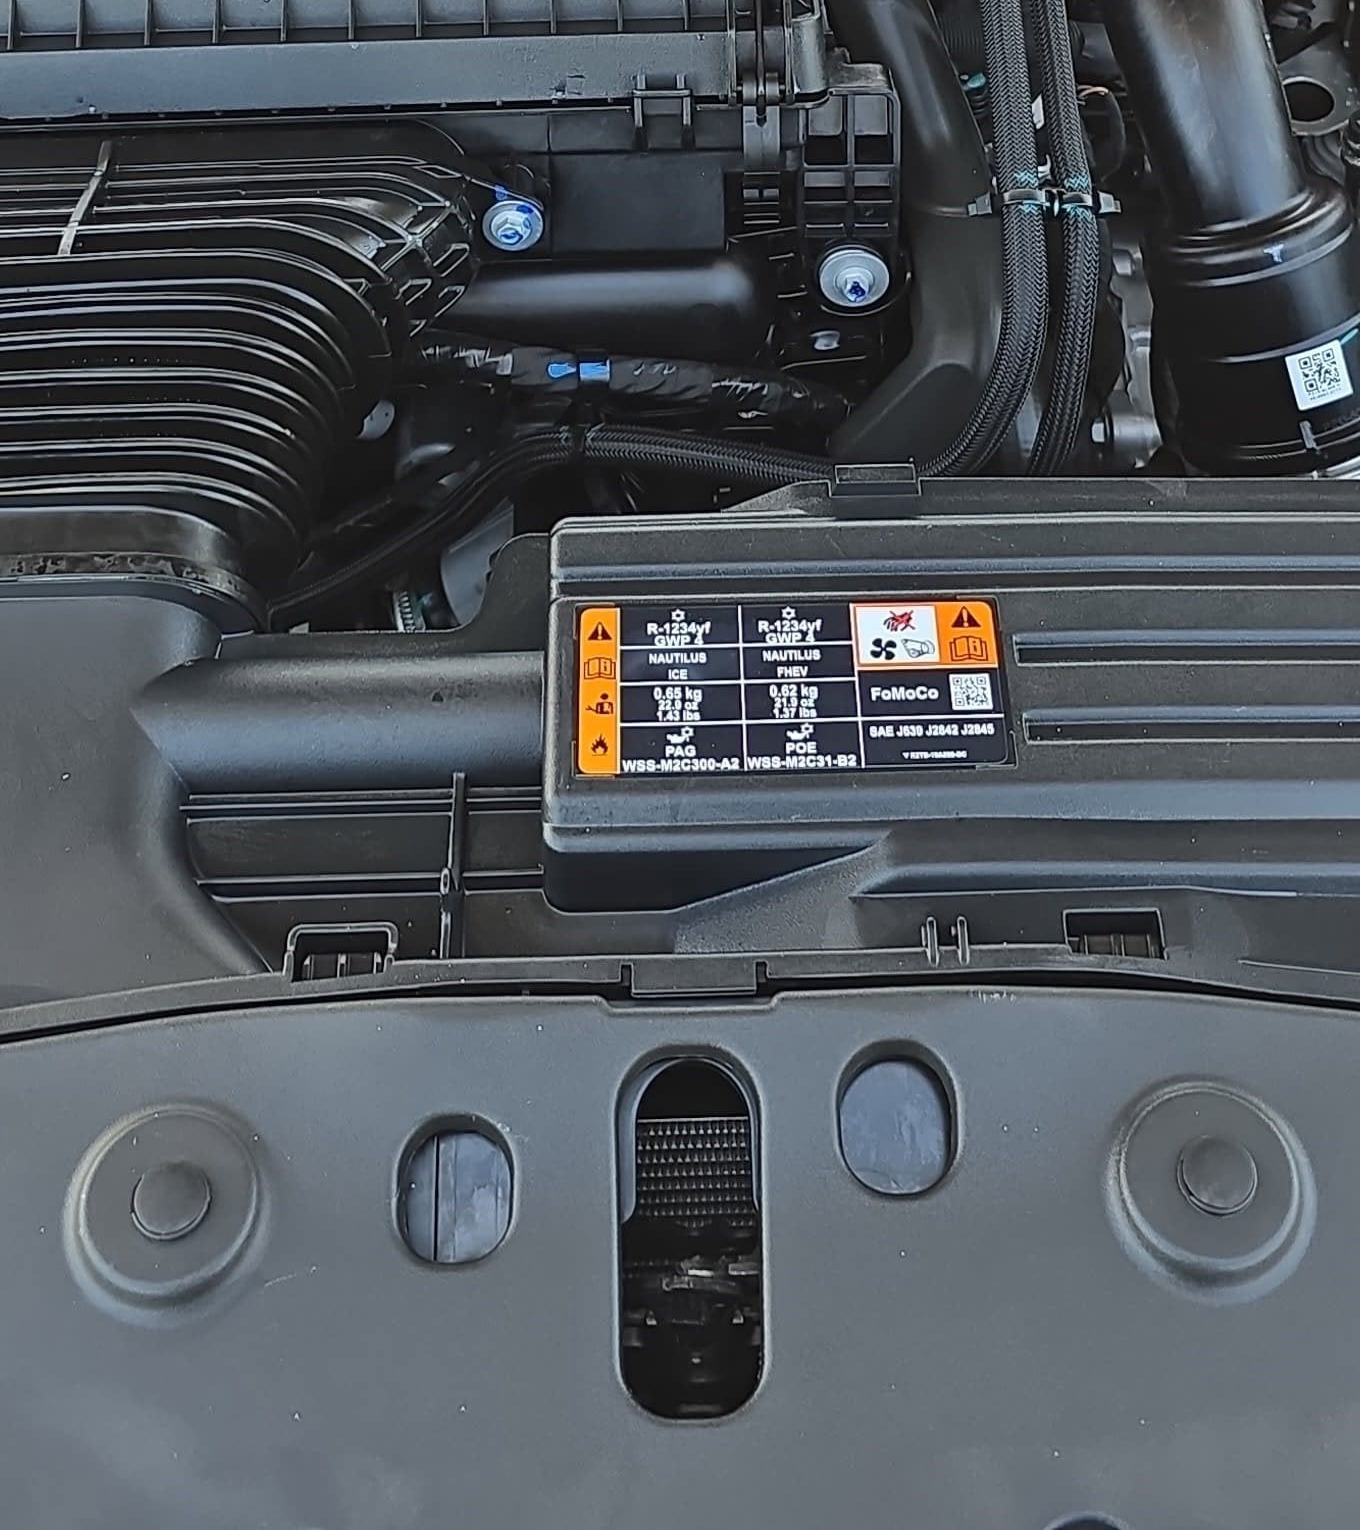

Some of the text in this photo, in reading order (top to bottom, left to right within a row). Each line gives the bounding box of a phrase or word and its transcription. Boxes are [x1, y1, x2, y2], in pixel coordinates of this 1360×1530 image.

[647, 621, 711, 635] R-1234yf
[758, 619, 822, 633] R-1234yf
[654, 635, 691, 647] GWP
[765, 633, 802, 644] GWP
[648, 652, 707, 664] NAUTILUS
[762, 649, 821, 662] NAUTILUS
[668, 669, 688, 680] ICE
[777, 666, 808, 678] FHEV
[653, 686, 702, 702] 0.65 kg
[769, 683, 818, 699] 0.62 kg
[870, 686, 939, 701] FoMoCo
[684, 701, 699, 710] oz
[800, 699, 815, 708] oz
[656, 710, 700, 722] 1.43 lbs
[773, 707, 817, 719] 1.37 lbs
[869, 725, 895, 738] SAE
[665, 745, 696, 757] PAG
[785, 742, 817, 754] POE
[622, 758, 739, 772] WSS-M2C300-A2
[747, 755, 857, 769] WSS-M2C31-B2
